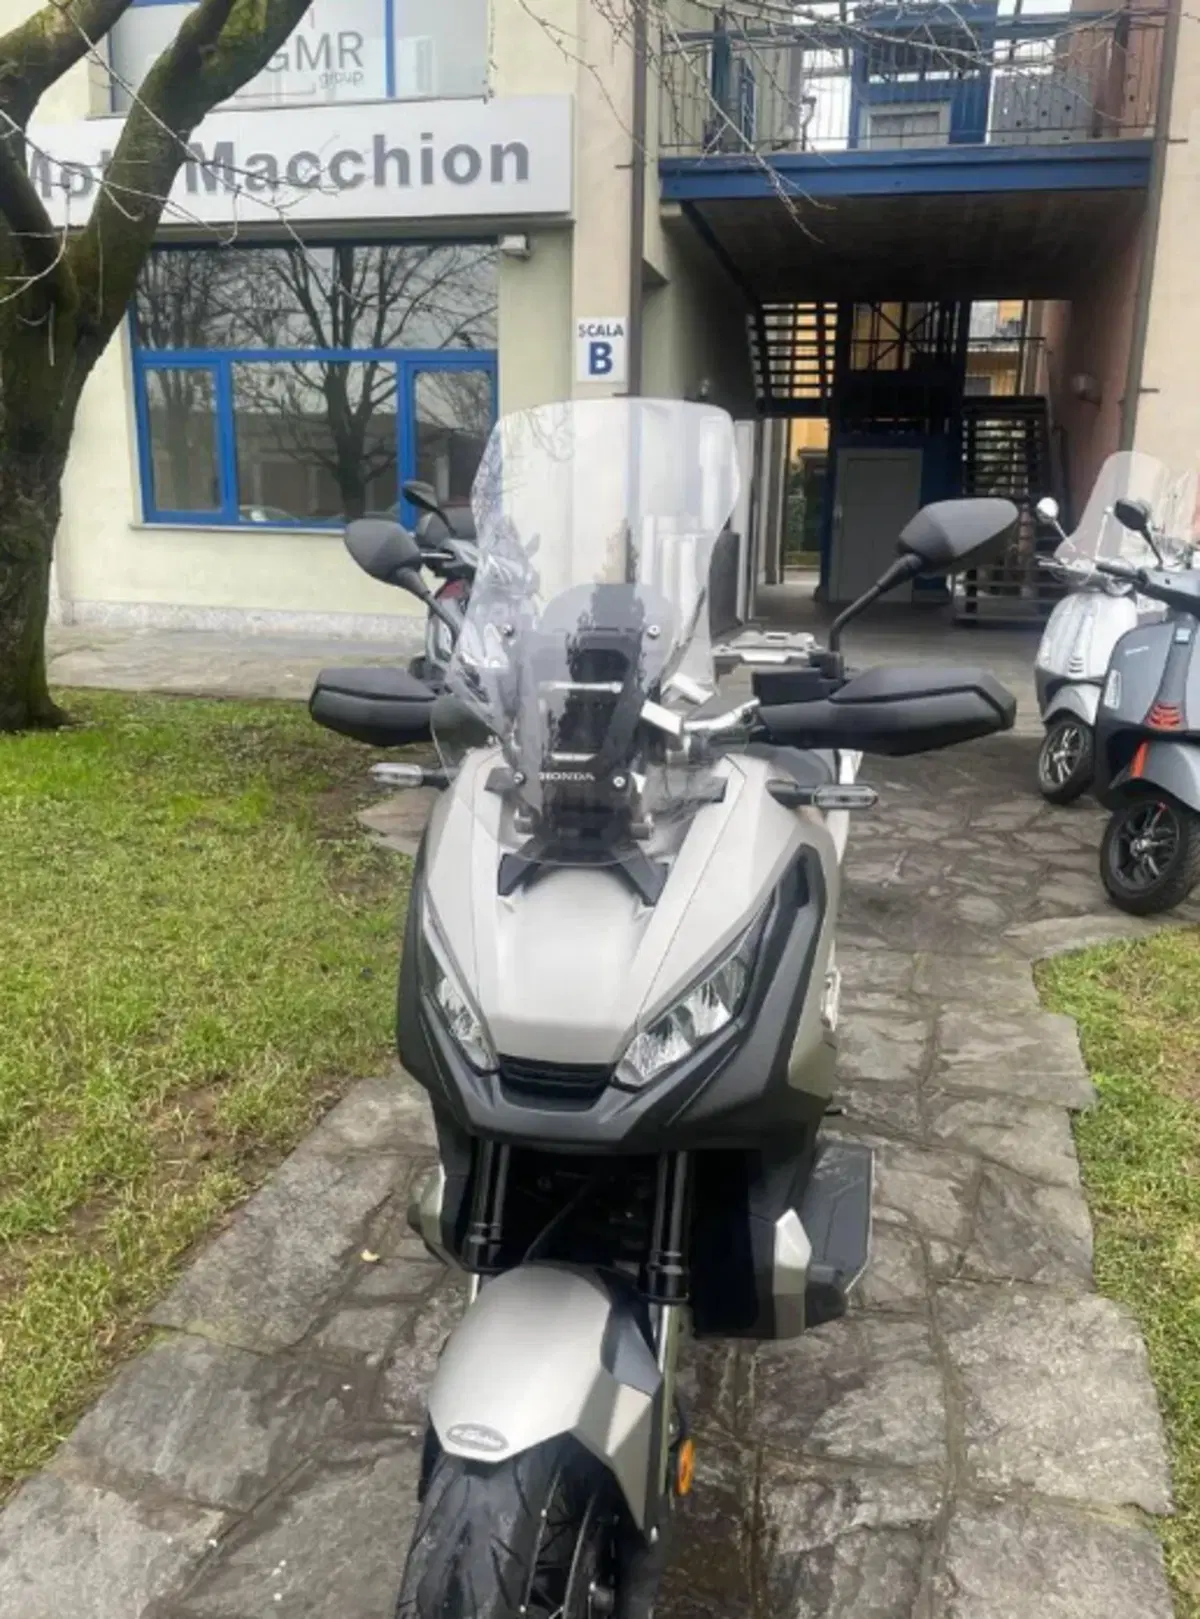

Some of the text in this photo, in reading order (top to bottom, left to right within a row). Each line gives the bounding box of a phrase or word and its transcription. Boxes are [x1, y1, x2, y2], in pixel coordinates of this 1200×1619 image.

[319, 71, 364, 89] group
[185, 132, 530, 195] Macchion
[578, 323, 624, 338] SCALA
[589, 341, 613, 375] B
[539, 771, 596, 781] HONDA
